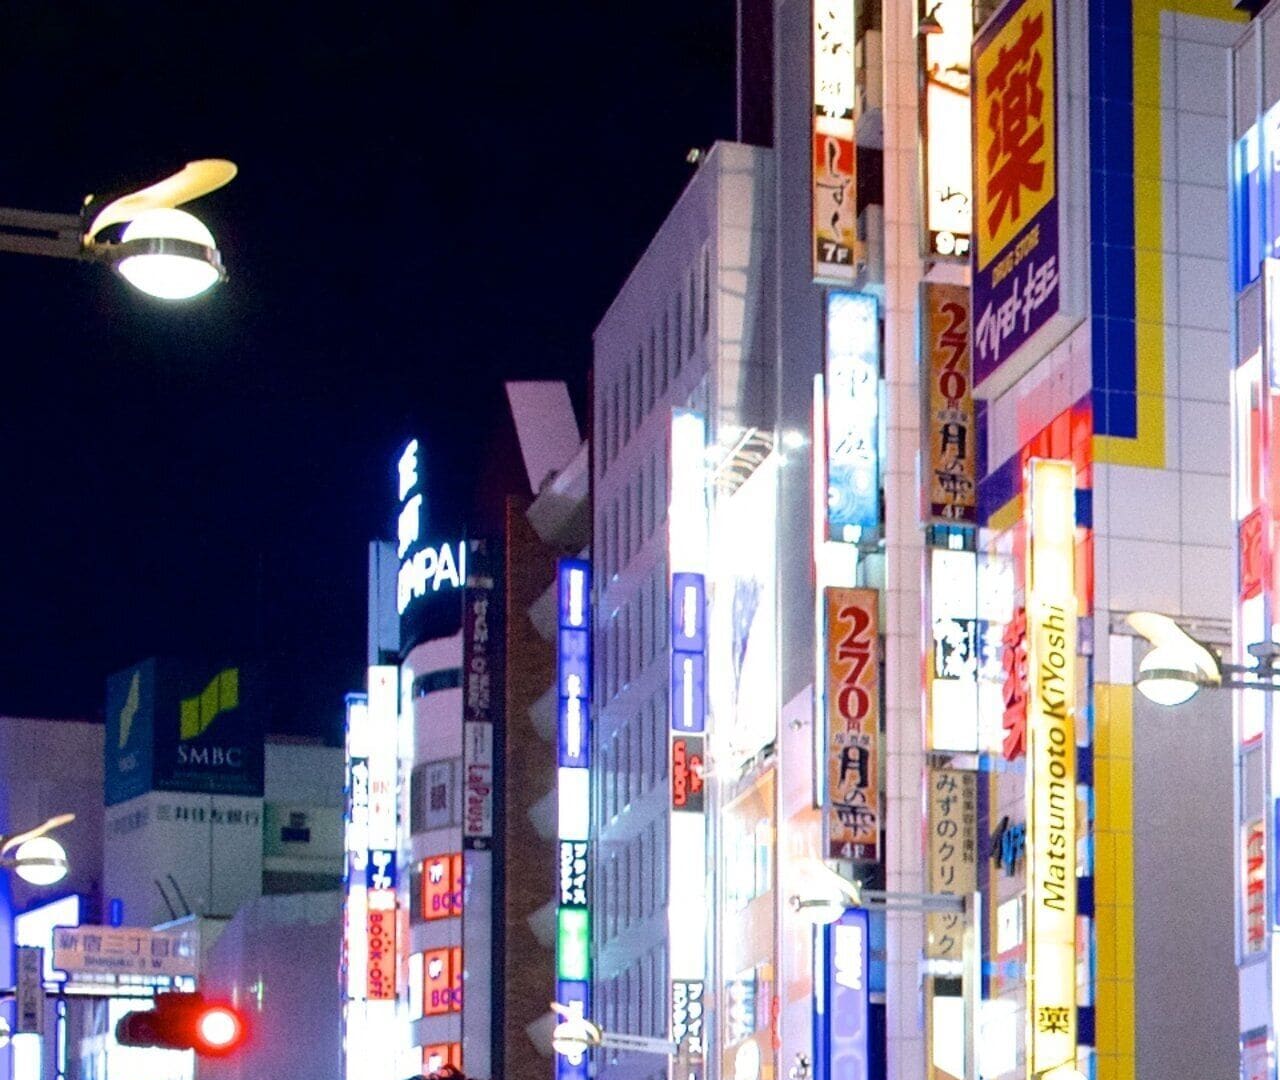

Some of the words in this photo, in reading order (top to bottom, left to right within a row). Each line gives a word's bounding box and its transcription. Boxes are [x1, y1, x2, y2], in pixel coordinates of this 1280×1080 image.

[986, 12, 1044, 240] 薬
[824, 244, 849, 261] 7F
[936, 232, 969, 256] 9F
[1042, 604, 1066, 720] KiYoshi
[177, 745, 241, 767] SMBC
[1043, 727, 1066, 911] Matsumoto
[840, 843, 866, 859] 4F
